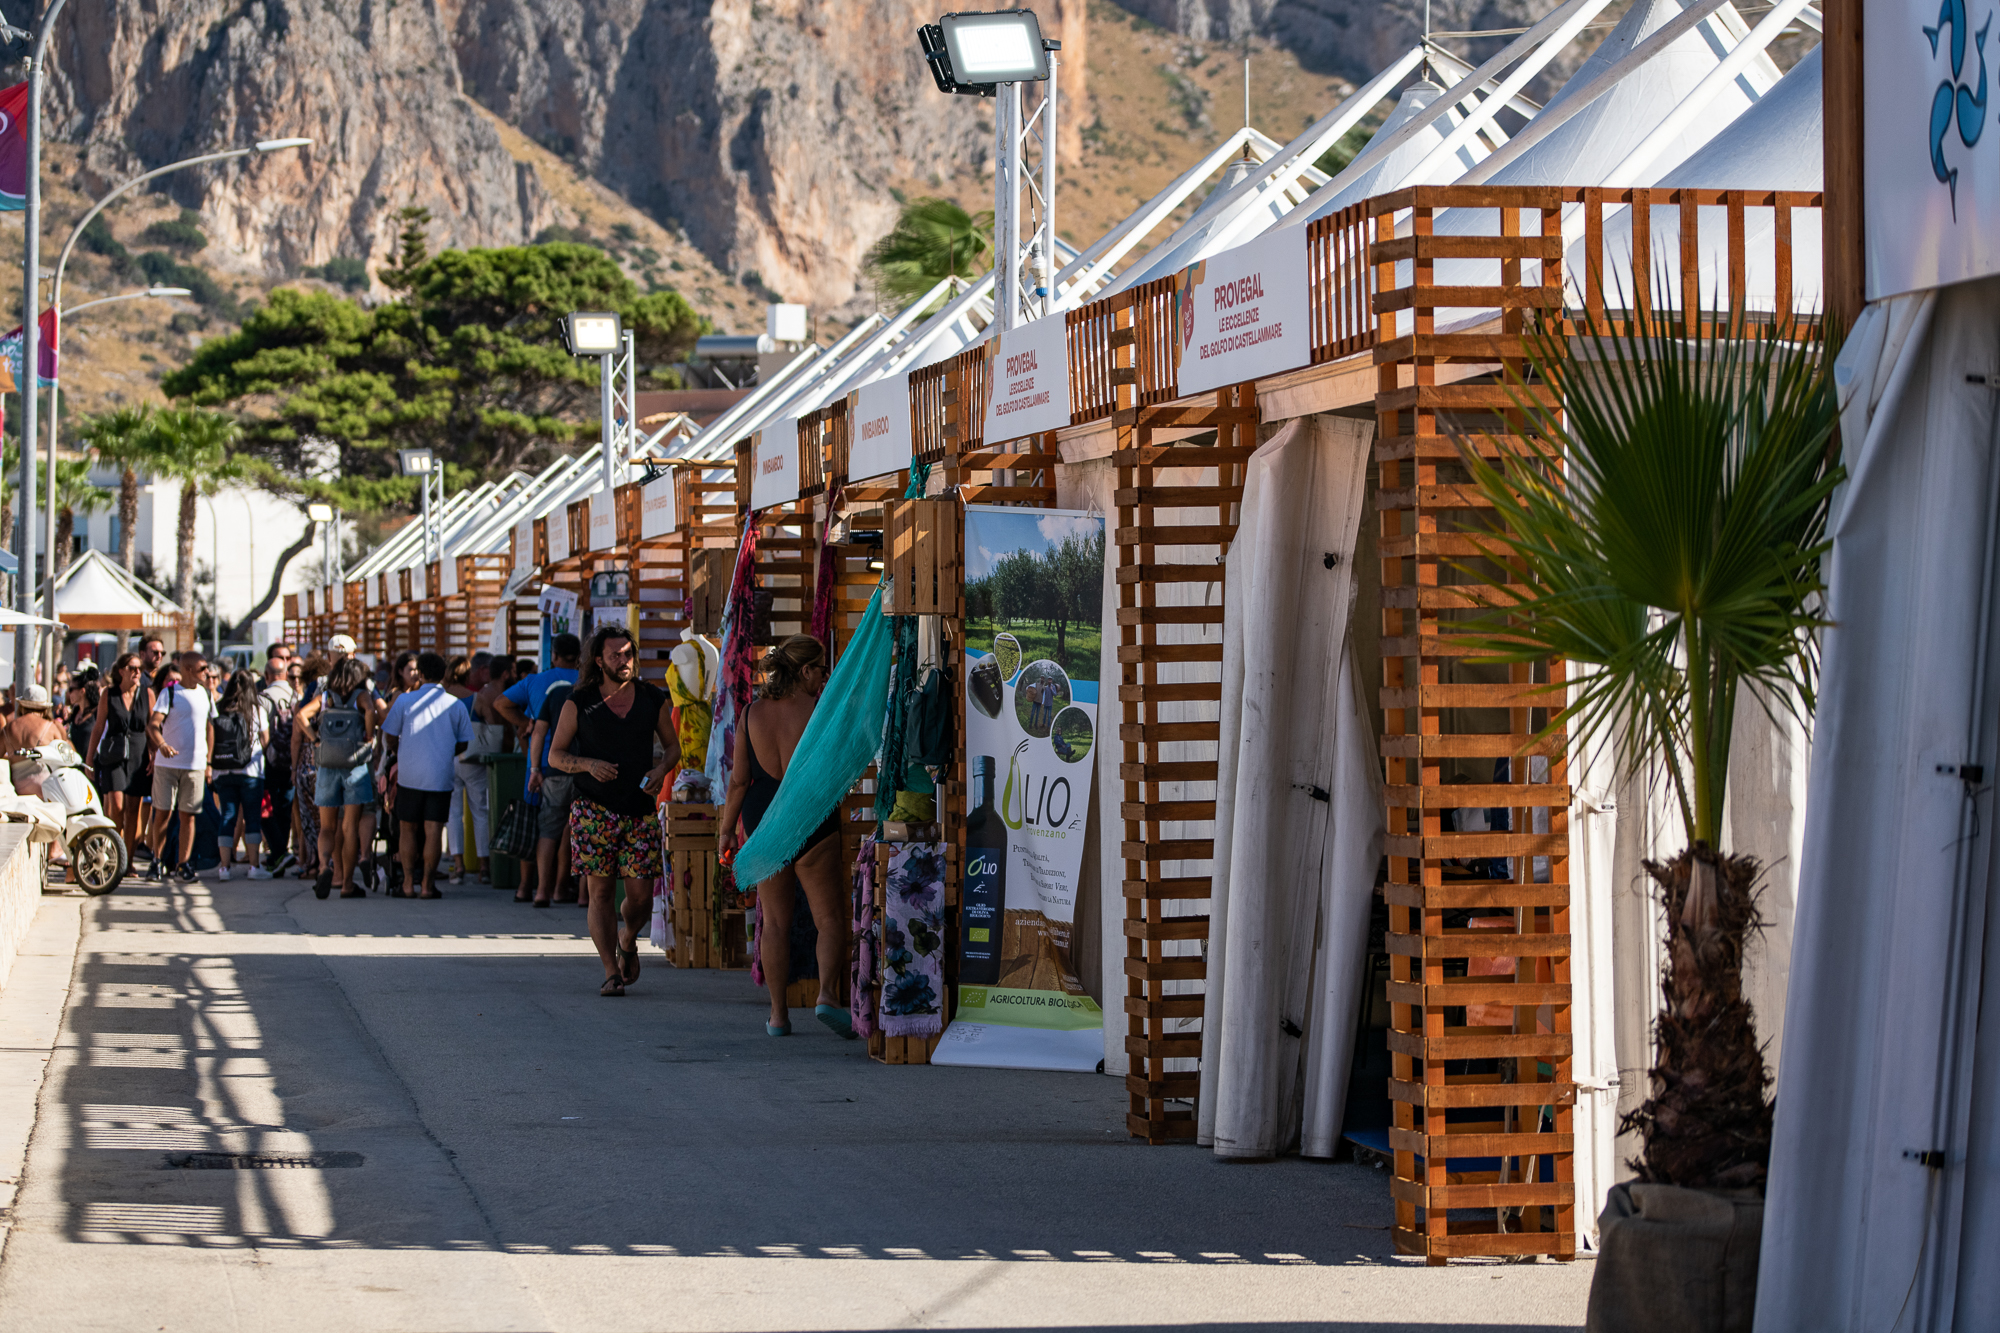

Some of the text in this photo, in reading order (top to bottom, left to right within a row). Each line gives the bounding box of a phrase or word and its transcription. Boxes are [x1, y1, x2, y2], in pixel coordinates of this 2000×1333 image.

[1214, 272, 1264, 312] PROVEGAL
[1219, 307, 1259, 333] LE ECCELLENZE
[1200, 322, 1282, 360] DEL GOLFO DI CASTELLAMMARE
[1006, 349, 1038, 378] PROVEGAL
[1019, 390, 1050, 411] CASTELLAMMARE
[990, 994, 1046, 1007] AGRICOLTURA
